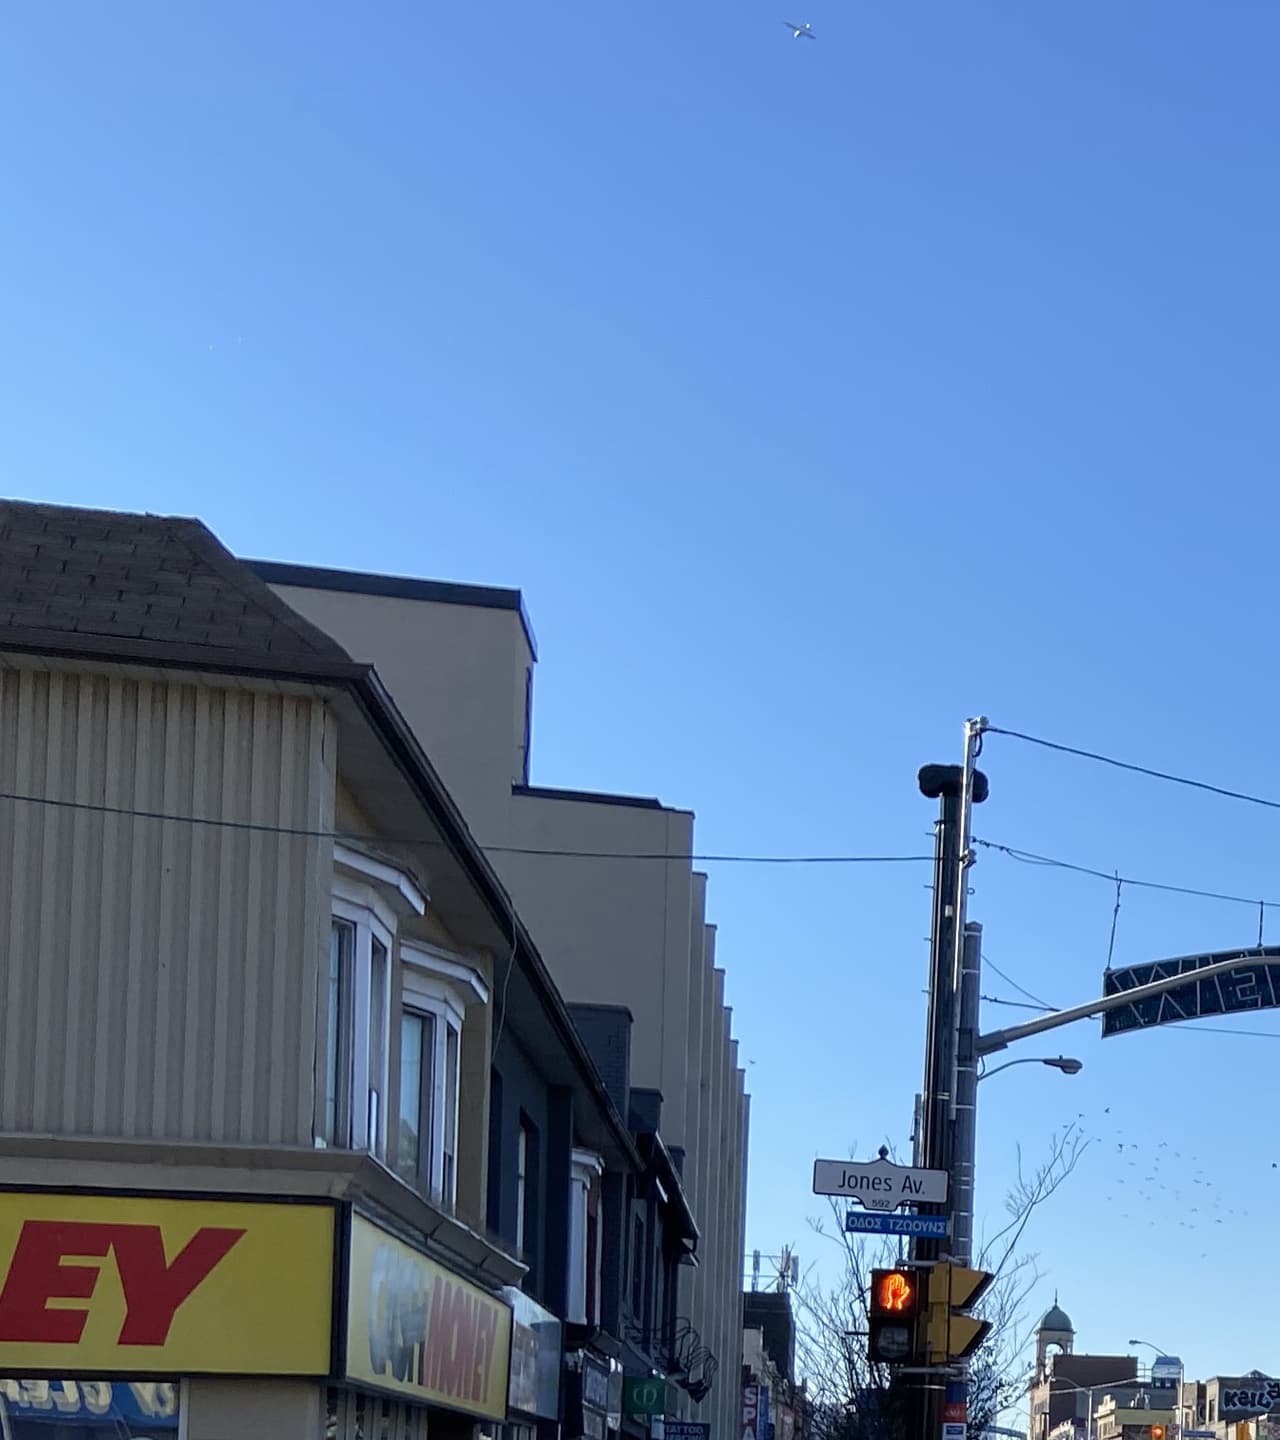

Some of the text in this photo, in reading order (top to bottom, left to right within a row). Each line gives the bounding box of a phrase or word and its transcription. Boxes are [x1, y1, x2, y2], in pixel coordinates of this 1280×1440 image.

[838, 1169, 926, 1195] Jones Av.
[872, 1199, 890, 1208] 592
